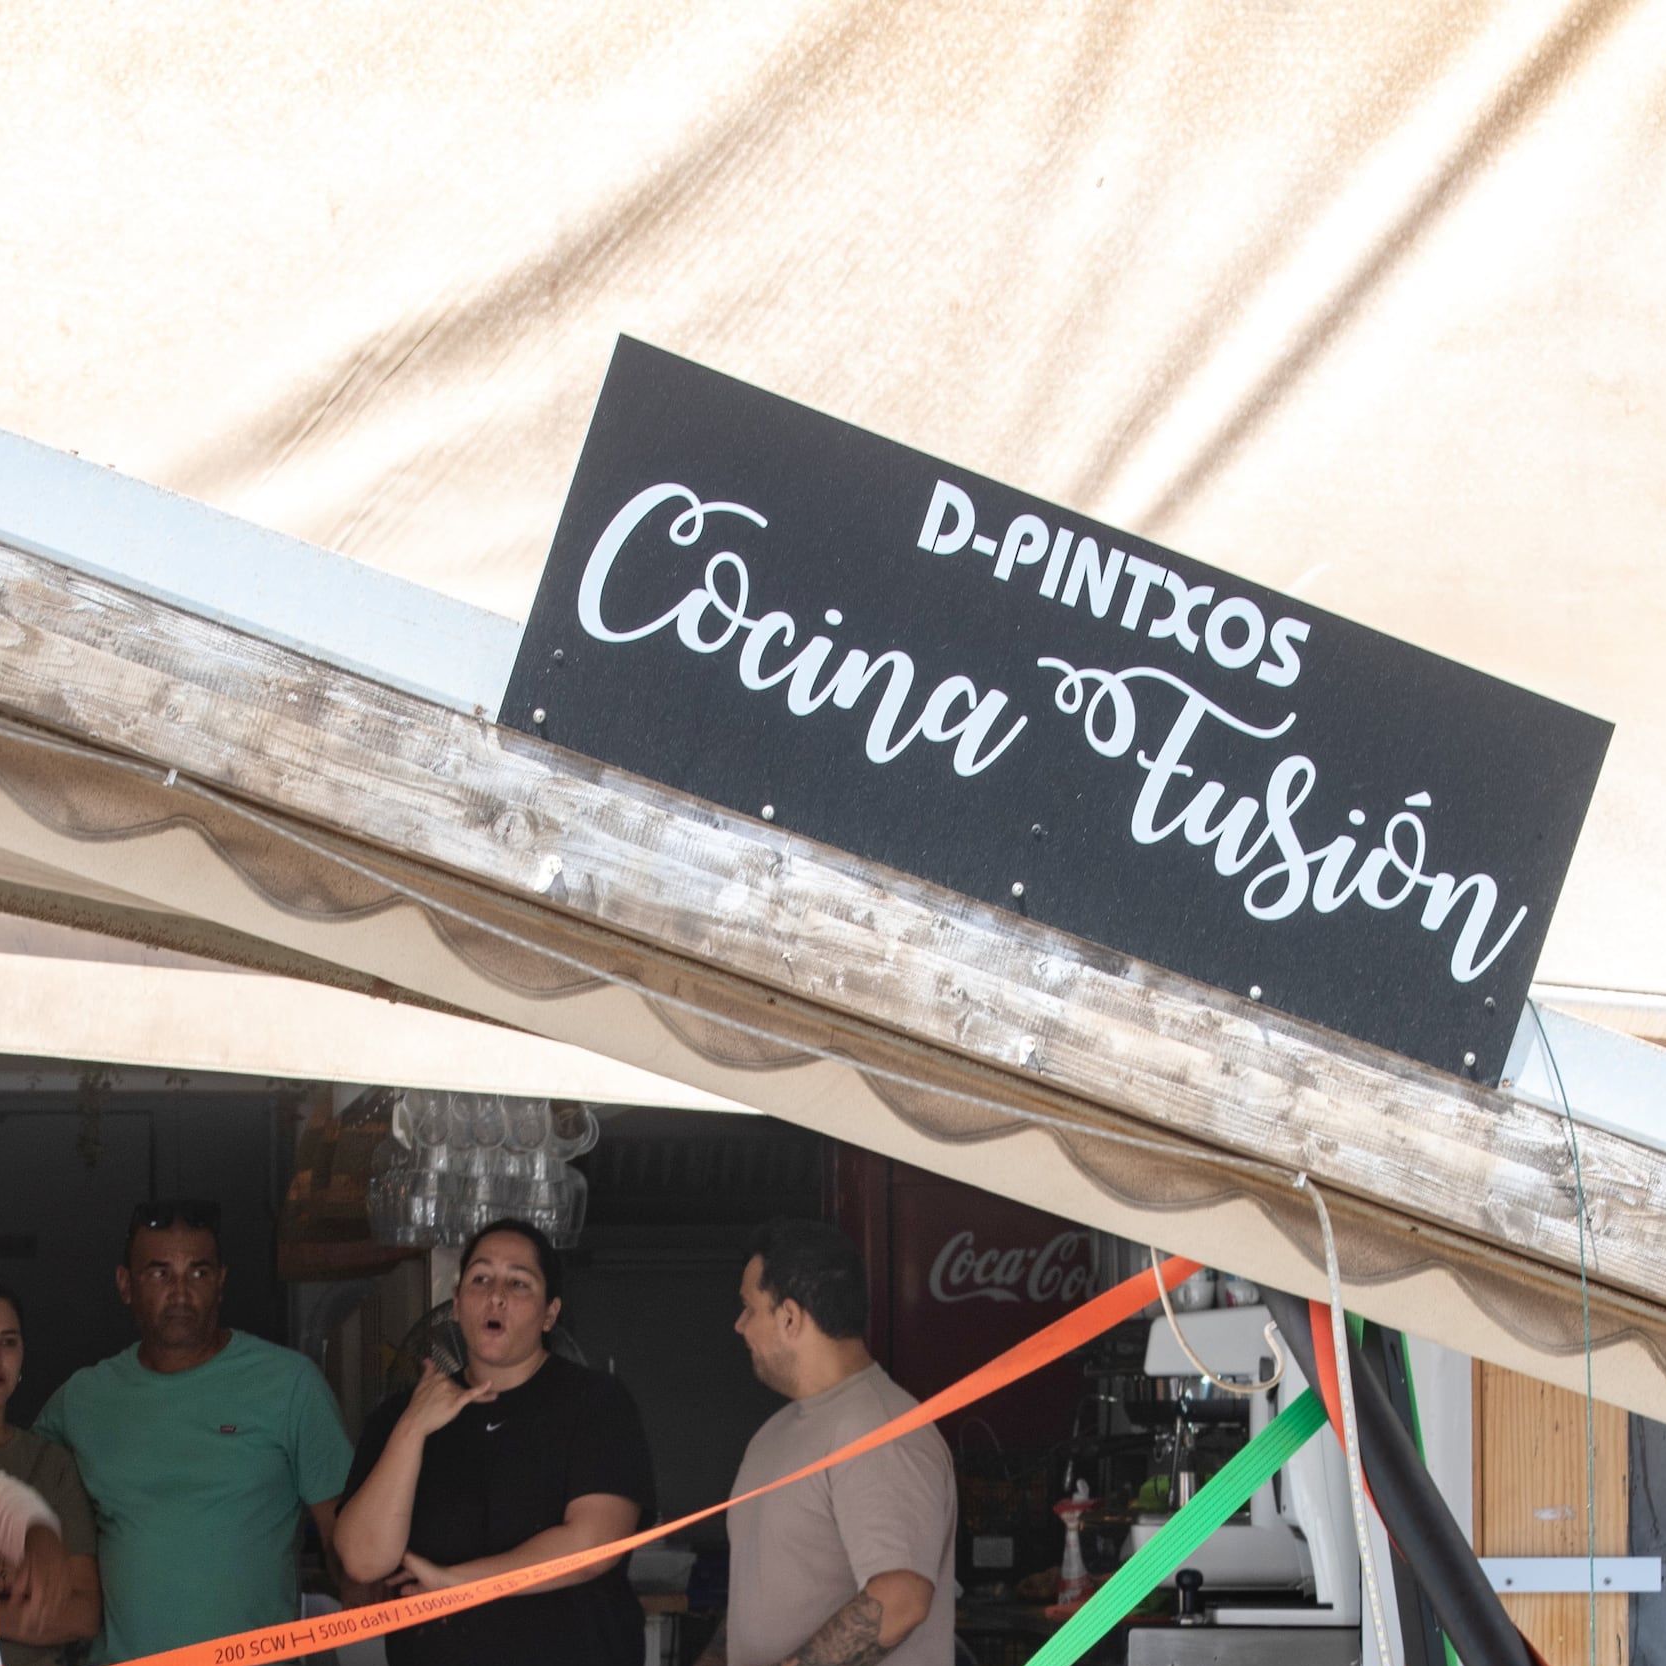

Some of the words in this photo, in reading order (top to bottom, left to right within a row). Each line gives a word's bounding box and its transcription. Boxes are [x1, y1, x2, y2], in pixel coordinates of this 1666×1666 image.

[917, 478, 1311, 688] D-PINTXOS
[576, 481, 1029, 779] Cocina
[1035, 654, 1528, 984] Fusión
[928, 1230, 1100, 1304] Coca-Co
[214, 1644, 246, 1666] 200
[249, 1634, 286, 1658] SCW
[318, 1618, 358, 1641] 5000
[360, 1611, 391, 1631] daN
